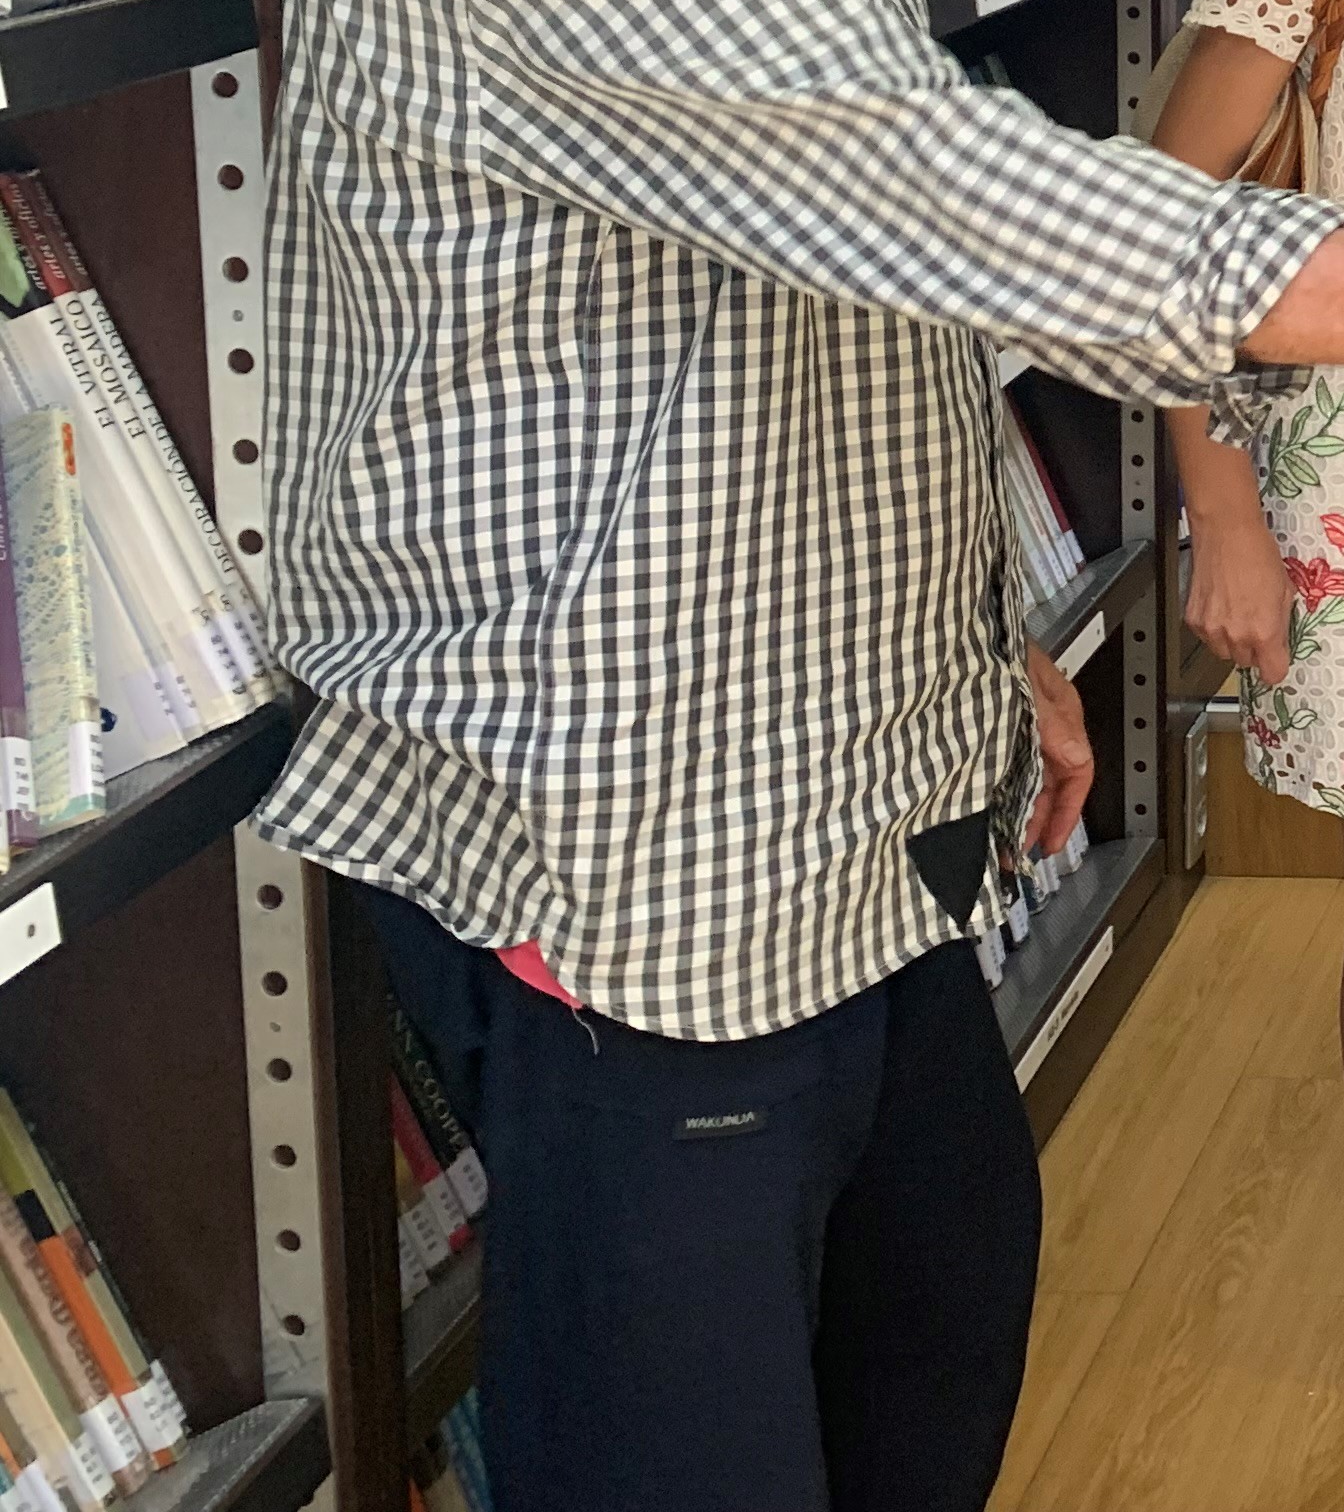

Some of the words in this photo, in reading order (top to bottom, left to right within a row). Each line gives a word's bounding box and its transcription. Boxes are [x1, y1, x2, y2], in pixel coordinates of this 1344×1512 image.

[47, 312, 98, 396] VITRAL
[63, 295, 130, 407] MOSAICO
[88, 295, 139, 380] MADERA
[93, 404, 114, 429] EL
[123, 412, 147, 440] EL
[147, 413, 169, 441] DE
[156, 442, 235, 576] DECORACIÓN
